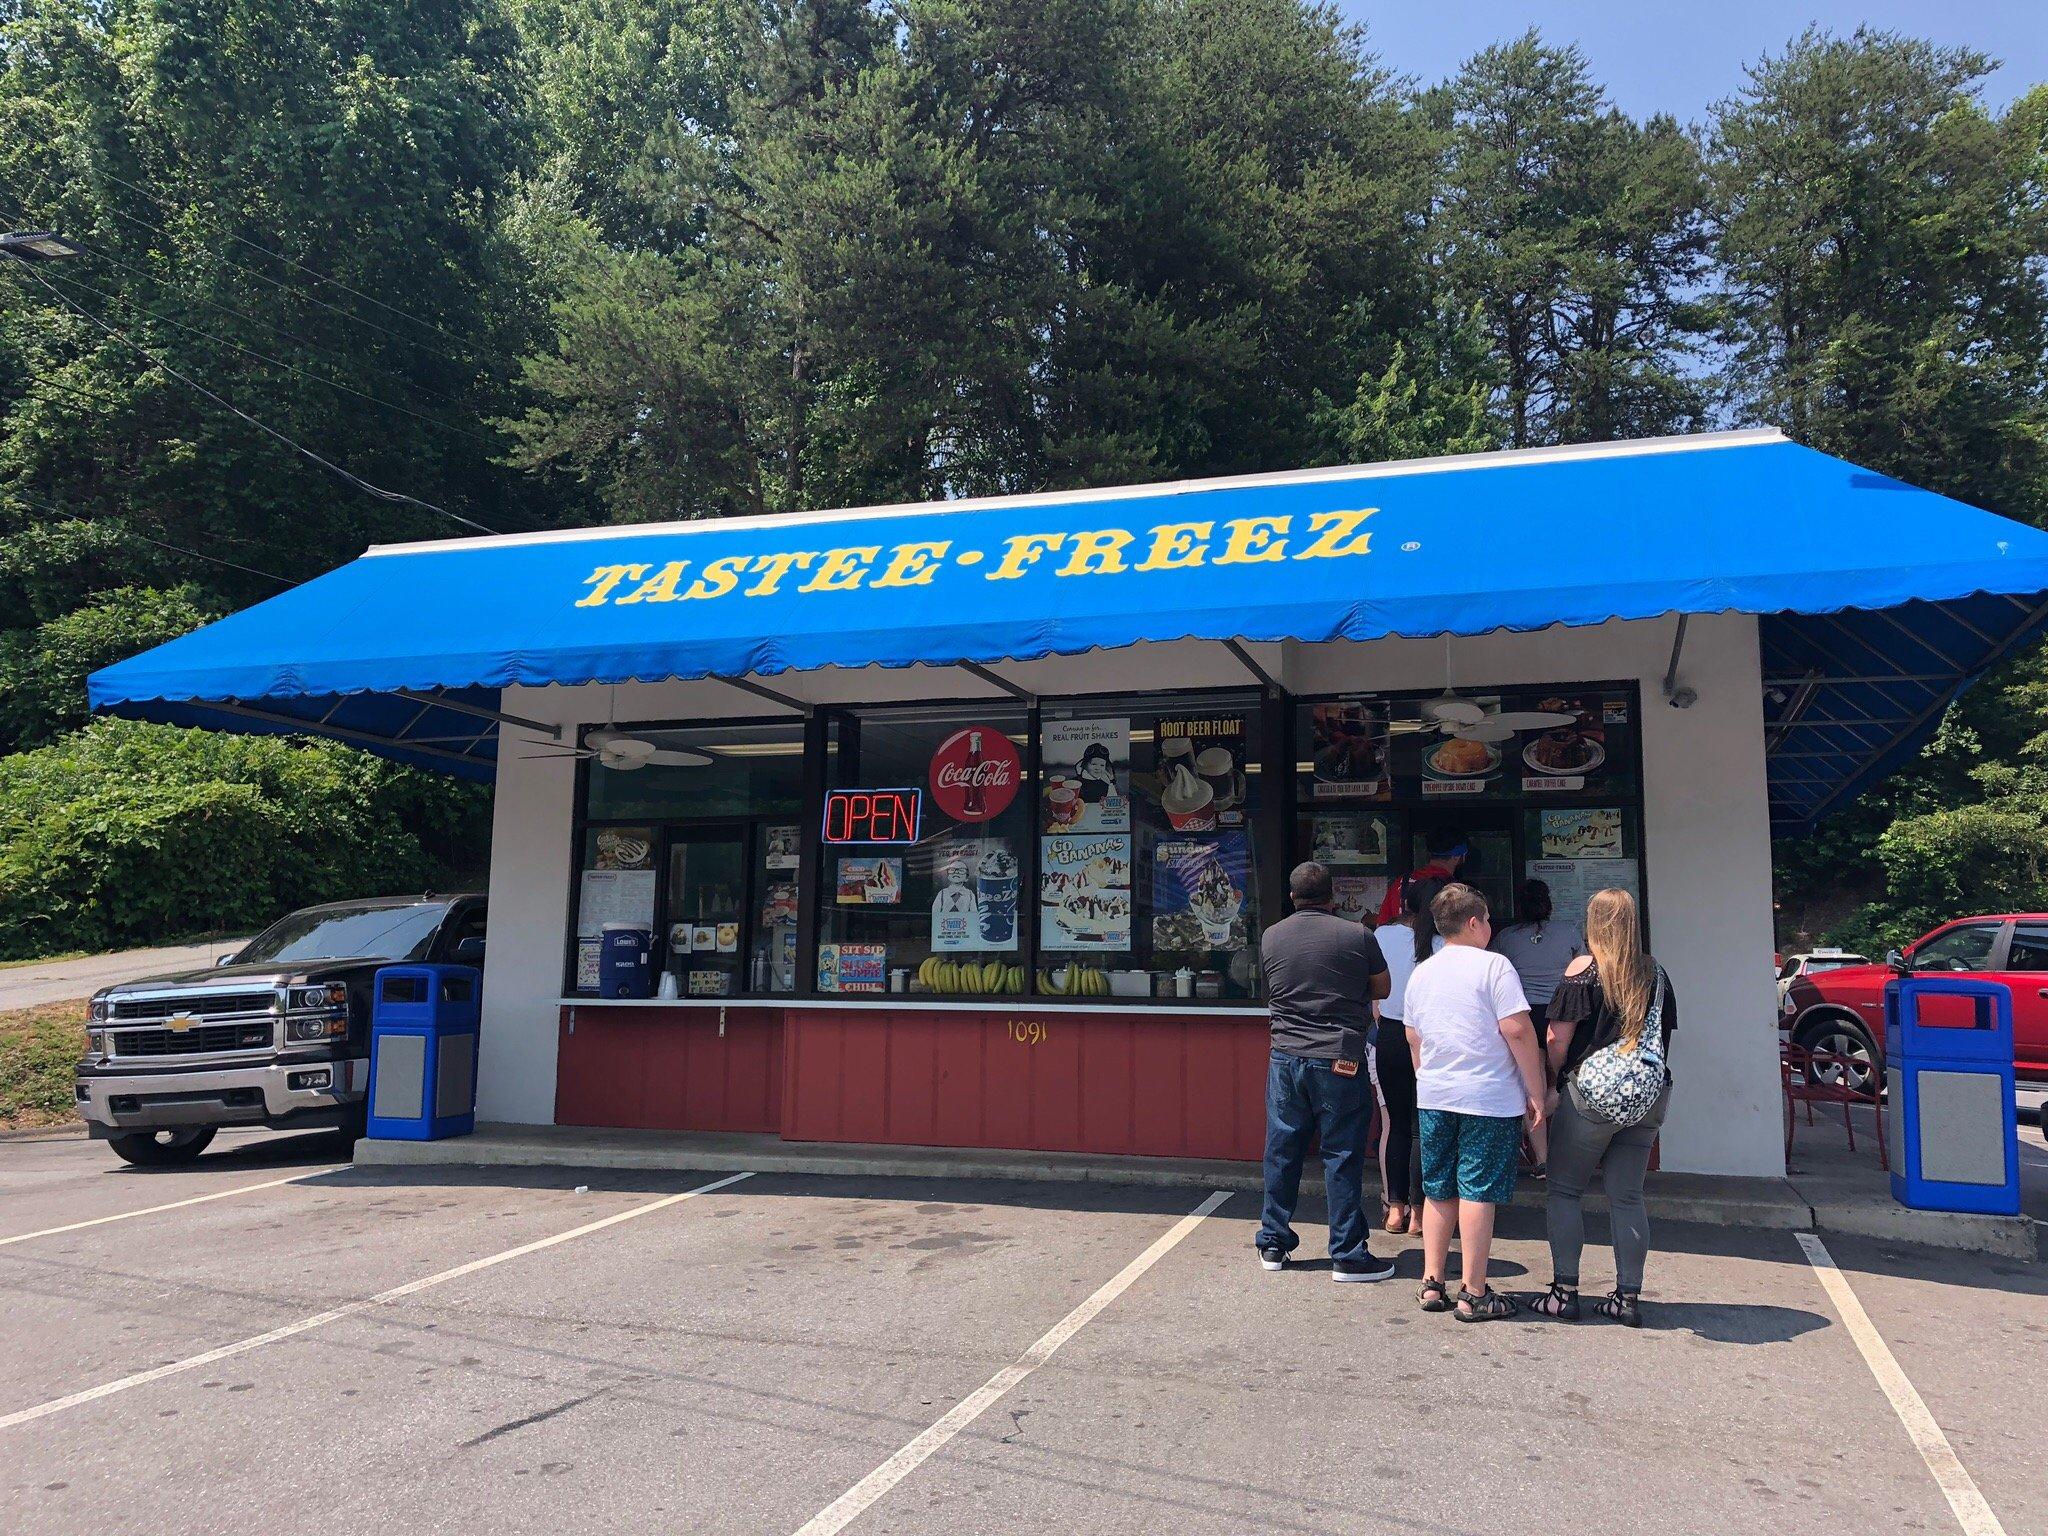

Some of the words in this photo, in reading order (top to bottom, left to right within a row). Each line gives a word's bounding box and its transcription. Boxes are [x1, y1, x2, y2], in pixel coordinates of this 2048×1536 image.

[575, 540, 953, 608] TASTEE
[984, 507, 1381, 581] FREEZ
[1052, 733, 1069, 742] REAL
[1071, 733, 1089, 741] FRUIT
[1091, 731, 1119, 740] SHAKES
[1062, 725, 1084, 733] Coming
[1160, 721, 1186, 738] ROOT
[1187, 720, 1211, 737] BEER
[1212, 719, 1241, 736] FLOAT
[936, 758, 1013, 789] Coca-Cola
[825, 793, 918, 842] OPEN
[1051, 838, 1074, 853] GO
[1056, 837, 1125, 865] BANANAS
[841, 944, 862, 955] SIT
[863, 944, 885, 955] SIP
[1007, 1019, 1048, 1046] 1091
